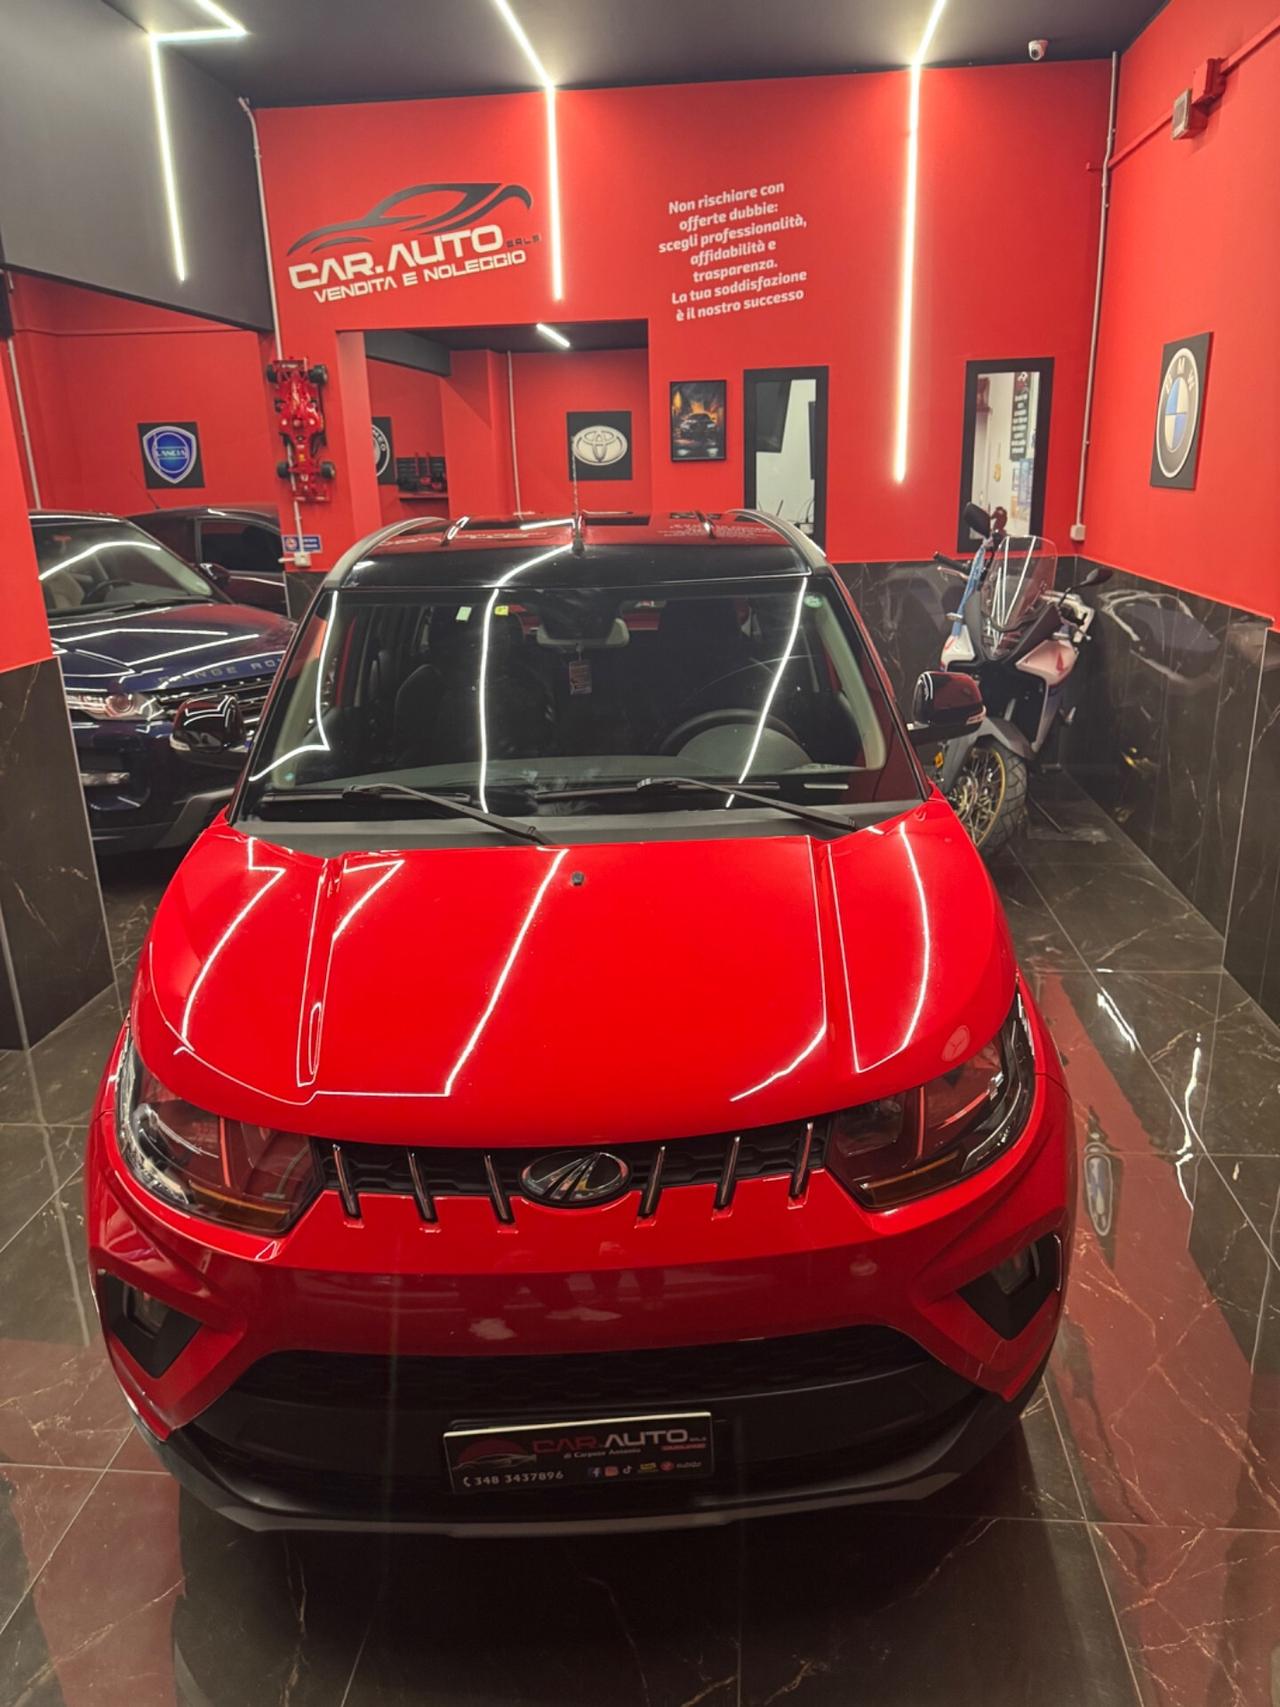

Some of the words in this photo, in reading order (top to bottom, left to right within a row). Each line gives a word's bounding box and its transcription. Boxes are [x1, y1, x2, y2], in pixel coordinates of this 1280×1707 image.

[669, 200, 695, 214] Non
[698, 187, 757, 208] rischiare
[760, 182, 784, 196] con
[679, 213, 726, 232] offerte
[729, 202, 778, 220] dubbie:
[659, 234, 698, 253] scegli
[701, 214, 807, 248] professionalità,
[288, 224, 504, 289] CAR.AUTO
[690, 240, 765, 267] affidabilità
[768, 240, 776, 250] e
[314, 275, 397, 303] VENDITA
[402, 272, 418, 287] E
[423, 249, 527, 282] NOLEGGIO
[672, 292, 687, 304] La
[689, 288, 712, 302] tua
[714, 270, 807, 297] soddisfazione
[693, 259, 778, 283] trasparenza.
[676, 309, 684, 321] è
[687, 307, 695, 320] il
[698, 301, 741, 317] nostro
[744, 289, 804, 309] successo
[1165, 357, 1196, 394] BMW
[474, 1475, 500, 1486] 348
[504, 1470, 564, 1483] 3437896
